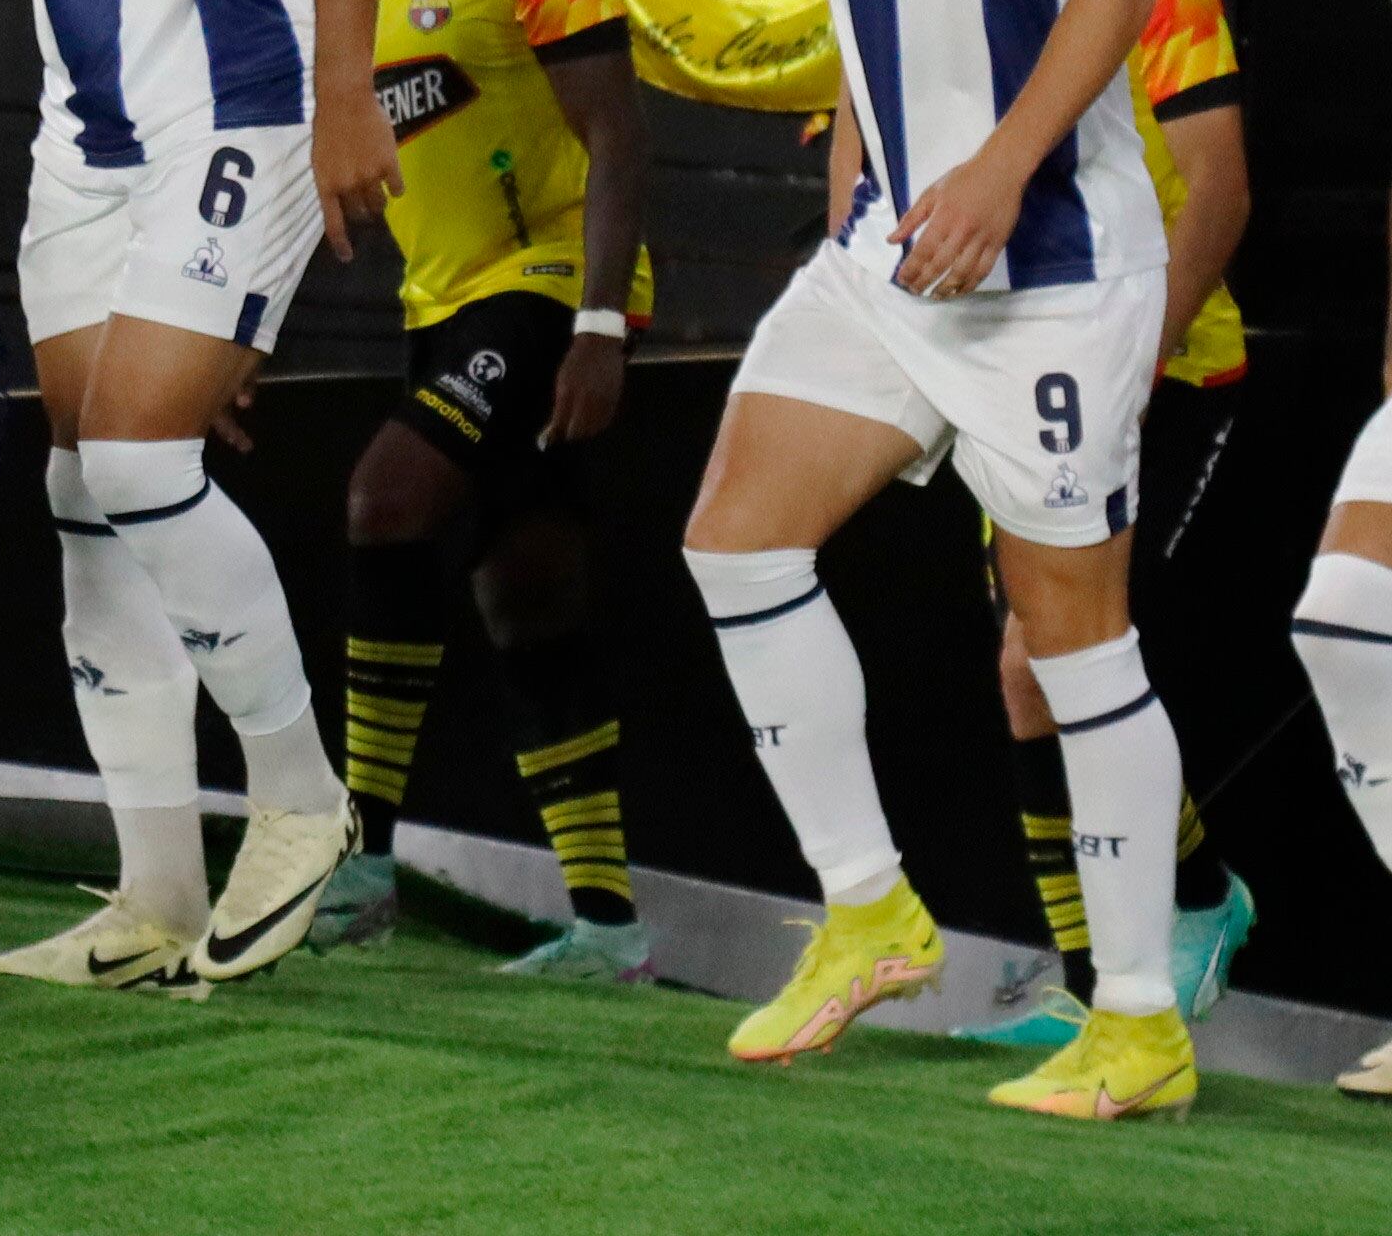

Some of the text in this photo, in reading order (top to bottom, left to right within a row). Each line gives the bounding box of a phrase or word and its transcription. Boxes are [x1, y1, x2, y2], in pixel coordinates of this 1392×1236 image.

[199, 146, 256, 228] 6
[415, 388, 482, 443] marathon
[1035, 372, 1083, 454] 9
